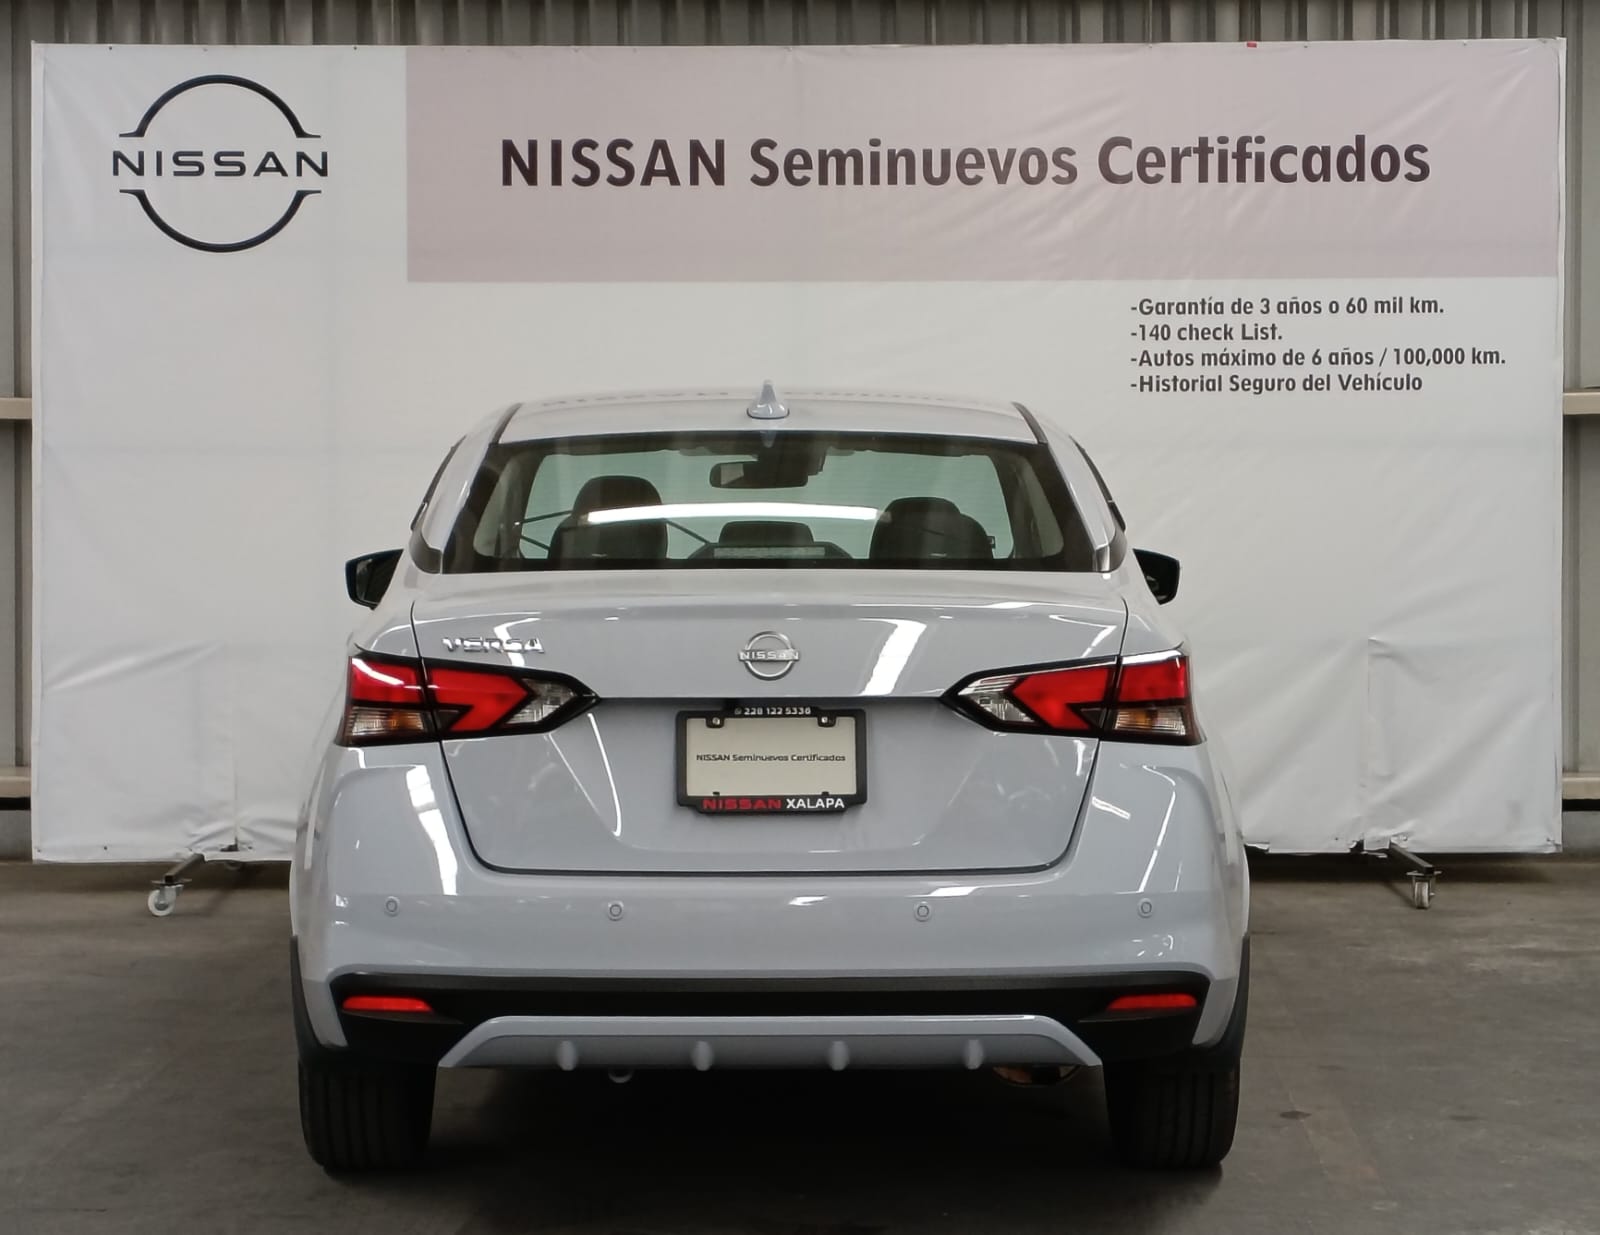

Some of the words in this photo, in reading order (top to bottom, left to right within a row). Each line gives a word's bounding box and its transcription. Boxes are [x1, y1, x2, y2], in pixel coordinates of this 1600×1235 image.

[112, 150, 329, 178] NISSAN
[501, 138, 726, 188] NISSAN
[749, 137, 1079, 188] Seminuevos
[1098, 134, 1431, 185] Certificados
[1130, 296, 1225, 316] -Garantía
[1230, 297, 1254, 315] de
[1259, 297, 1271, 315] 3
[1276, 296, 1323, 315] años
[1328, 300, 1340, 315] o
[1345, 297, 1368, 315] 60
[1374, 296, 1403, 314] mil
[1410, 296, 1445, 314] km.
[1130, 323, 1171, 342] -140
[1177, 323, 1234, 341] check
[1241, 322, 1283, 341] List.
[1130, 349, 1195, 367] -Autos
[1201, 347, 1277, 367] máximo
[1282, 348, 1306, 366] de
[1311, 348, 1322, 366] 6
[1328, 347, 1374, 366] años
[1393, 347, 1466, 367] 100,000
[1471, 346, 1507, 365] km.
[1130, 374, 1223, 393] -Historial
[1229, 374, 1297, 396] Seguro
[1302, 373, 1331, 392] del
[1337, 371, 1423, 392] Vehículo
[442, 637, 545, 653] VERSA
[739, 650, 799, 661] NISSAN
[696, 754, 730, 762] NISSAN
[732, 753, 789, 762] Seminuevos
[790, 753, 846, 762] Certificados
[702, 798, 782, 810] NISSAN
[786, 797, 845, 809] XALAPA
